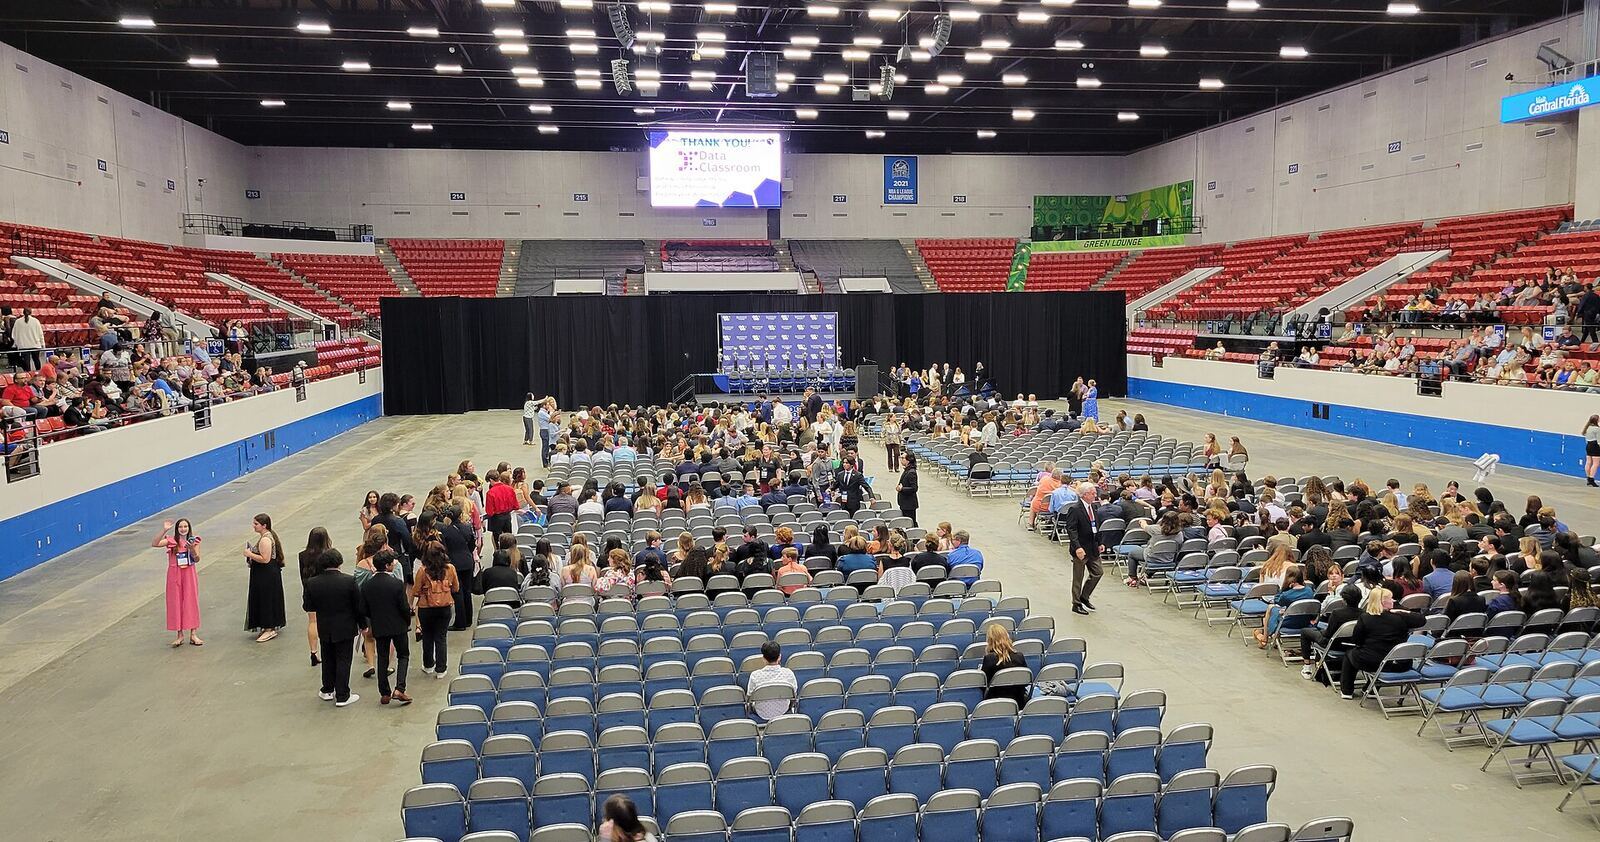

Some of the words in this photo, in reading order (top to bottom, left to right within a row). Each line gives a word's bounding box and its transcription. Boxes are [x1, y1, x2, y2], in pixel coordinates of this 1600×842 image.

[1529, 97, 1558, 115] Central
[1559, 93, 1590, 108] Florida
[681, 138, 720, 147] THANK
[724, 138, 751, 147] YOU!
[700, 151, 727, 160] Data
[700, 162, 761, 172] Classroom
[1083, 240, 1111, 248] GREEN
[1111, 238, 1143, 247] LOUNGE
